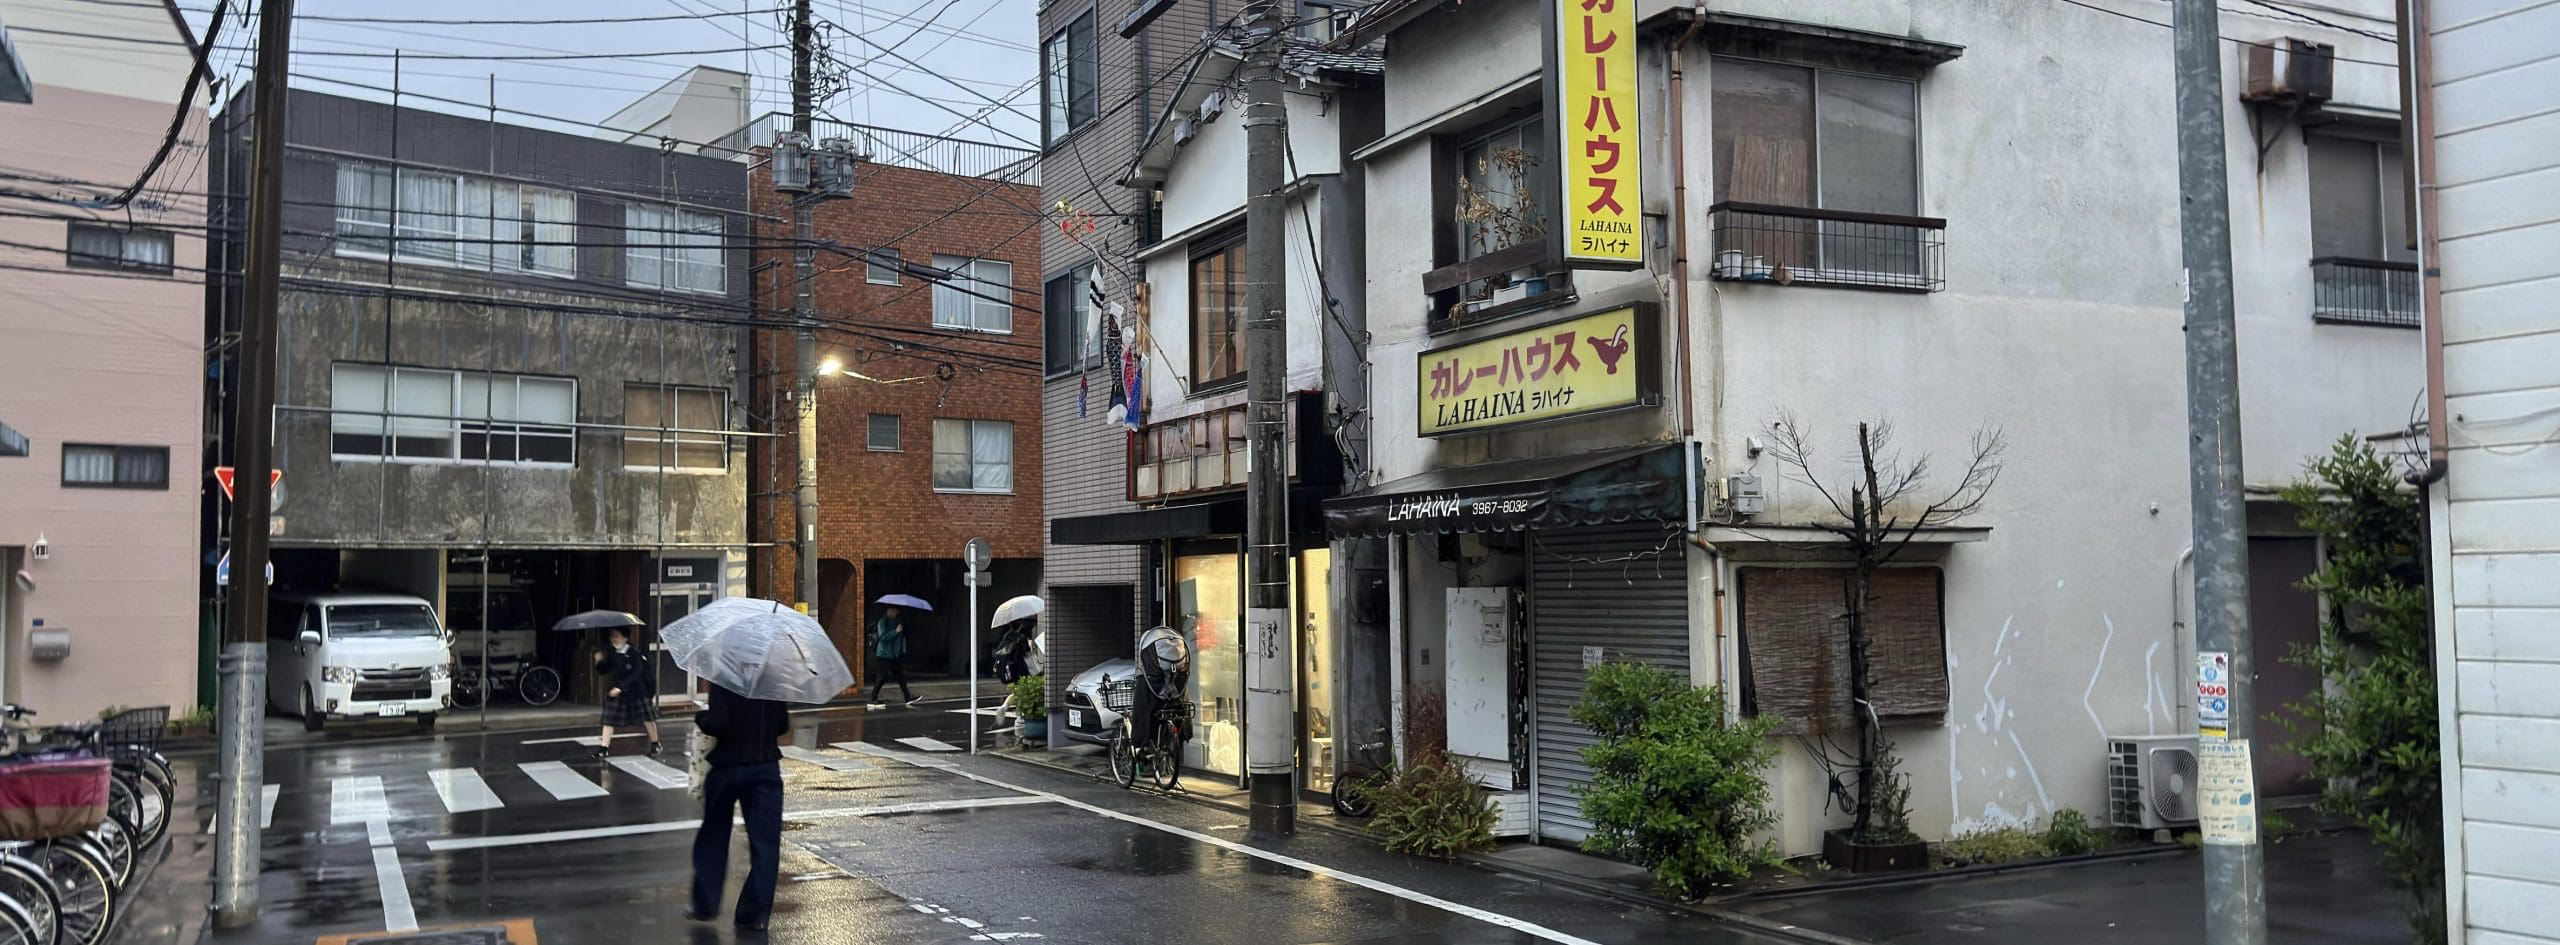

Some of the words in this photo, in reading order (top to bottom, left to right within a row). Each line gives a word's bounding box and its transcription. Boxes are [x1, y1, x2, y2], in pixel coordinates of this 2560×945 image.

[1579, 219, 1633, 235] LAHAINA
[1581, 236, 1630, 254] ラハイナ
[1430, 330, 1581, 401] カレーハウス
[1436, 389, 1527, 428] LAHAINA
[1531, 385, 1575, 412] ラハイナ
[1388, 492, 1461, 521] LAHAINA
[1472, 499, 1529, 516] 3967-8032
